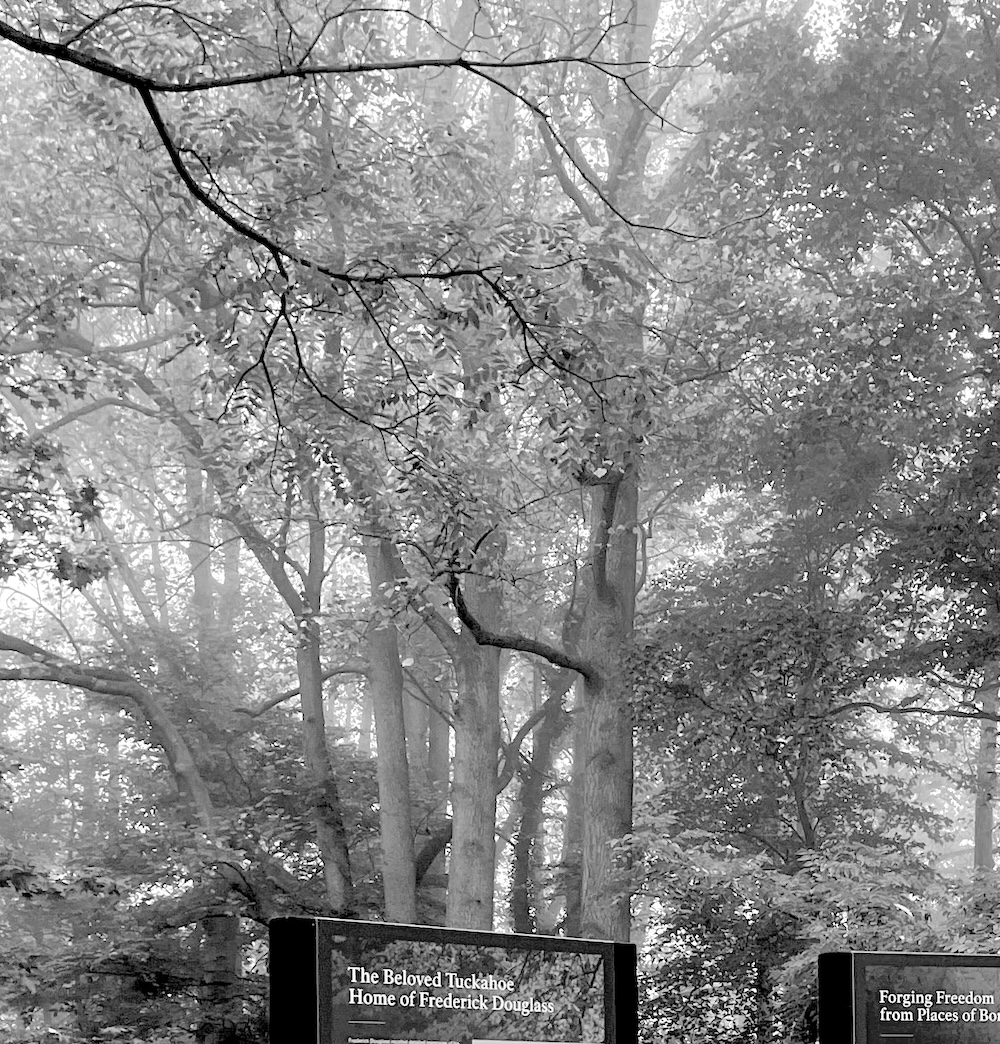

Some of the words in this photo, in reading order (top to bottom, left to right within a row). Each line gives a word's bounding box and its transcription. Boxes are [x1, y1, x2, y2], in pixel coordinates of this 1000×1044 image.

[348, 966, 379, 984] The
[383, 968, 442, 987] Beloved
[445, 972, 515, 991] Tuckahoe
[348, 988, 396, 1006] Home
[400, 990, 416, 1007] of
[419, 991, 488, 1010] Frederick
[492, 996, 555, 1016] Douglass
[879, 990, 933, 1007] Forging
[936, 990, 995, 1005] Freedom
[880, 1007, 913, 1022] from
[917, 1008, 959, 1022] Places
[962, 1008, 977, 1022] of
